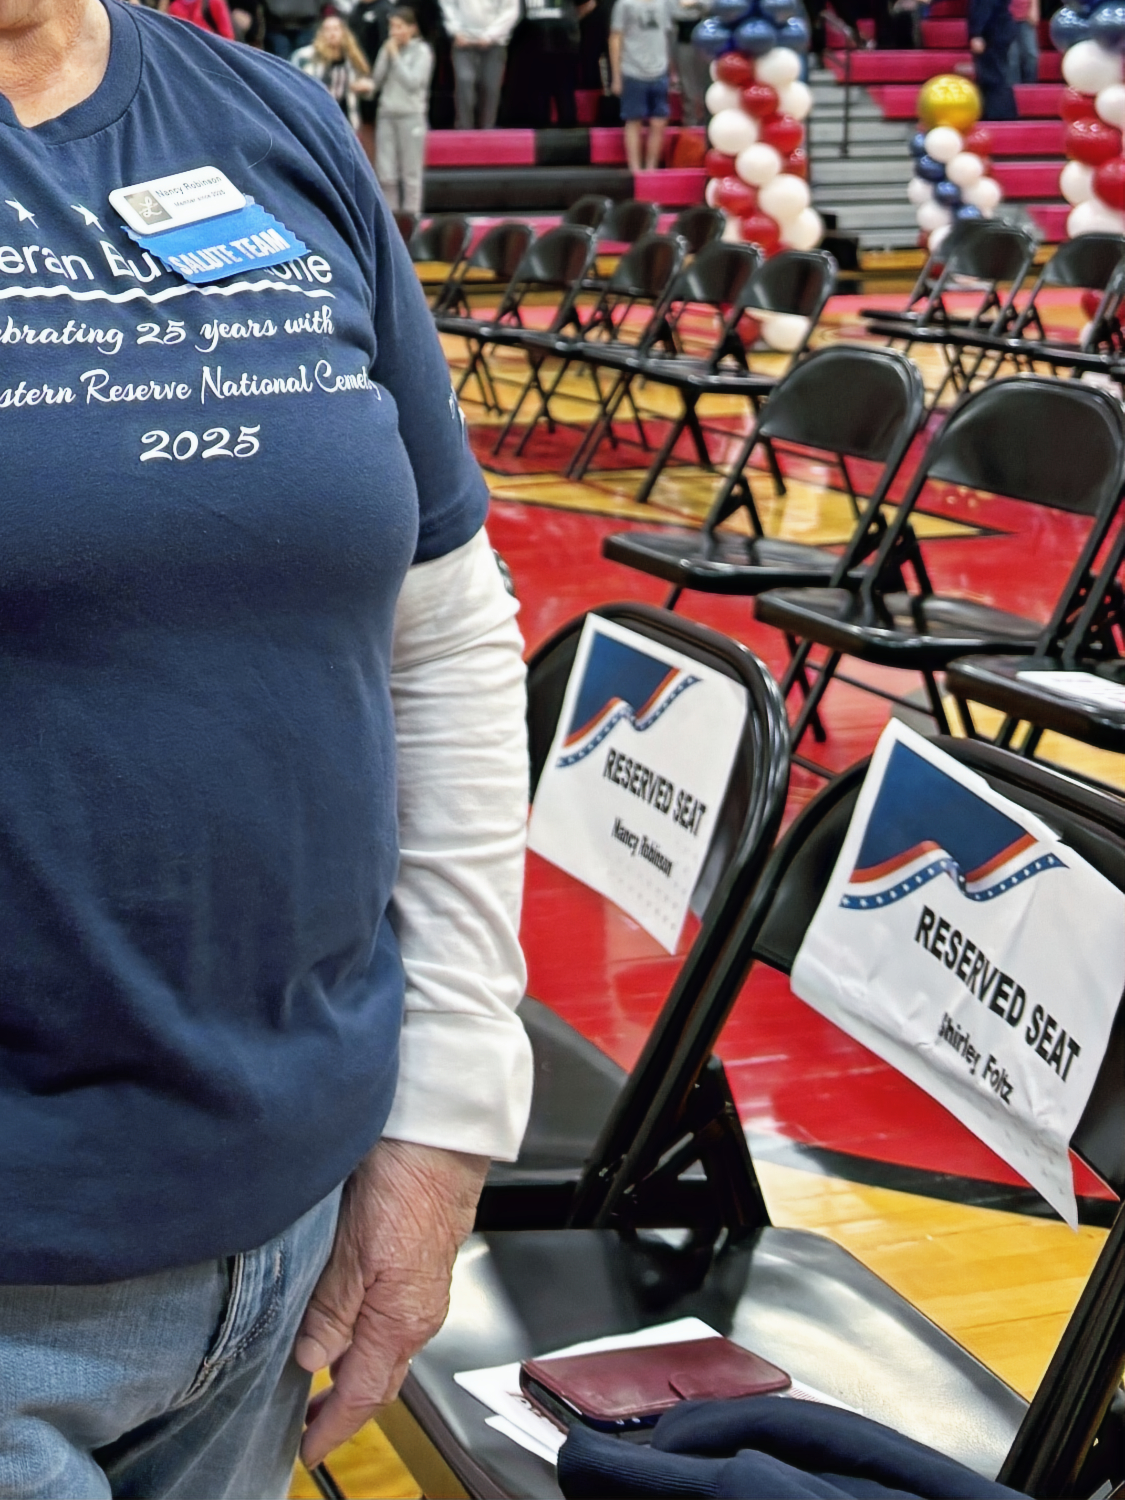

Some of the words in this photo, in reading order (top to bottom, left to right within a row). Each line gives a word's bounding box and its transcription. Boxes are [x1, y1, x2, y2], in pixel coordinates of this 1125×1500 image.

[156, 185, 184, 198] Nancy
[185, 175, 223, 191] Robinson
[168, 244, 243, 276] SALUTE
[229, 228, 291, 260] TEAM
[136, 320, 186, 345] 25
[195, 318, 277, 352] years
[284, 304, 335, 335] with
[80, 368, 191, 404] Reserve
[201, 365, 312, 405] National
[140, 424, 261, 462] 2025
[603, 747, 674, 815] RESERVED
[673, 788, 707, 836] SEAT
[611, 816, 639, 857] Nancy
[639, 834, 673, 877] Robinson
[914, 904, 1027, 1028] RESERVED
[1025, 1004, 1082, 1083] SEAT
[938, 1011, 982, 1076] Shirley
[982, 1053, 1015, 1105] Foltz
